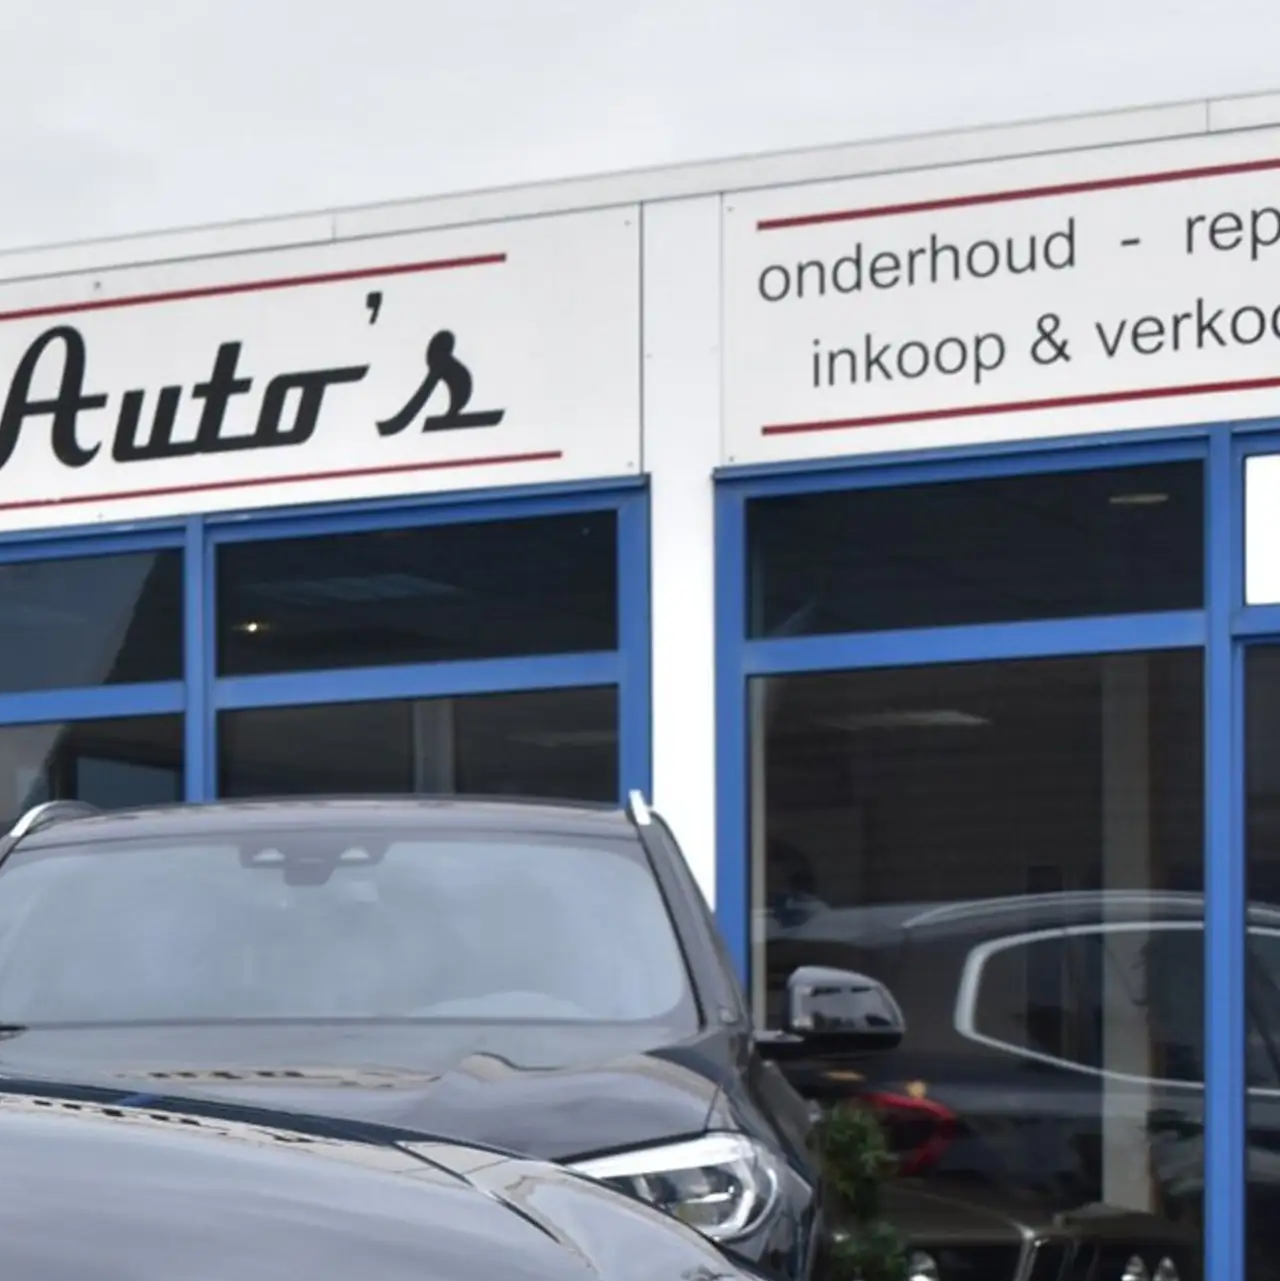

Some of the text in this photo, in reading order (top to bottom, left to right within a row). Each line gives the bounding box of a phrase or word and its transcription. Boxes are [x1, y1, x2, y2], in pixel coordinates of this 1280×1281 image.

[757, 217, 1076, 301] onderhoud
[1185, 206, 1280, 261] rep
[811, 297, 1280, 388] inkoop & verko
